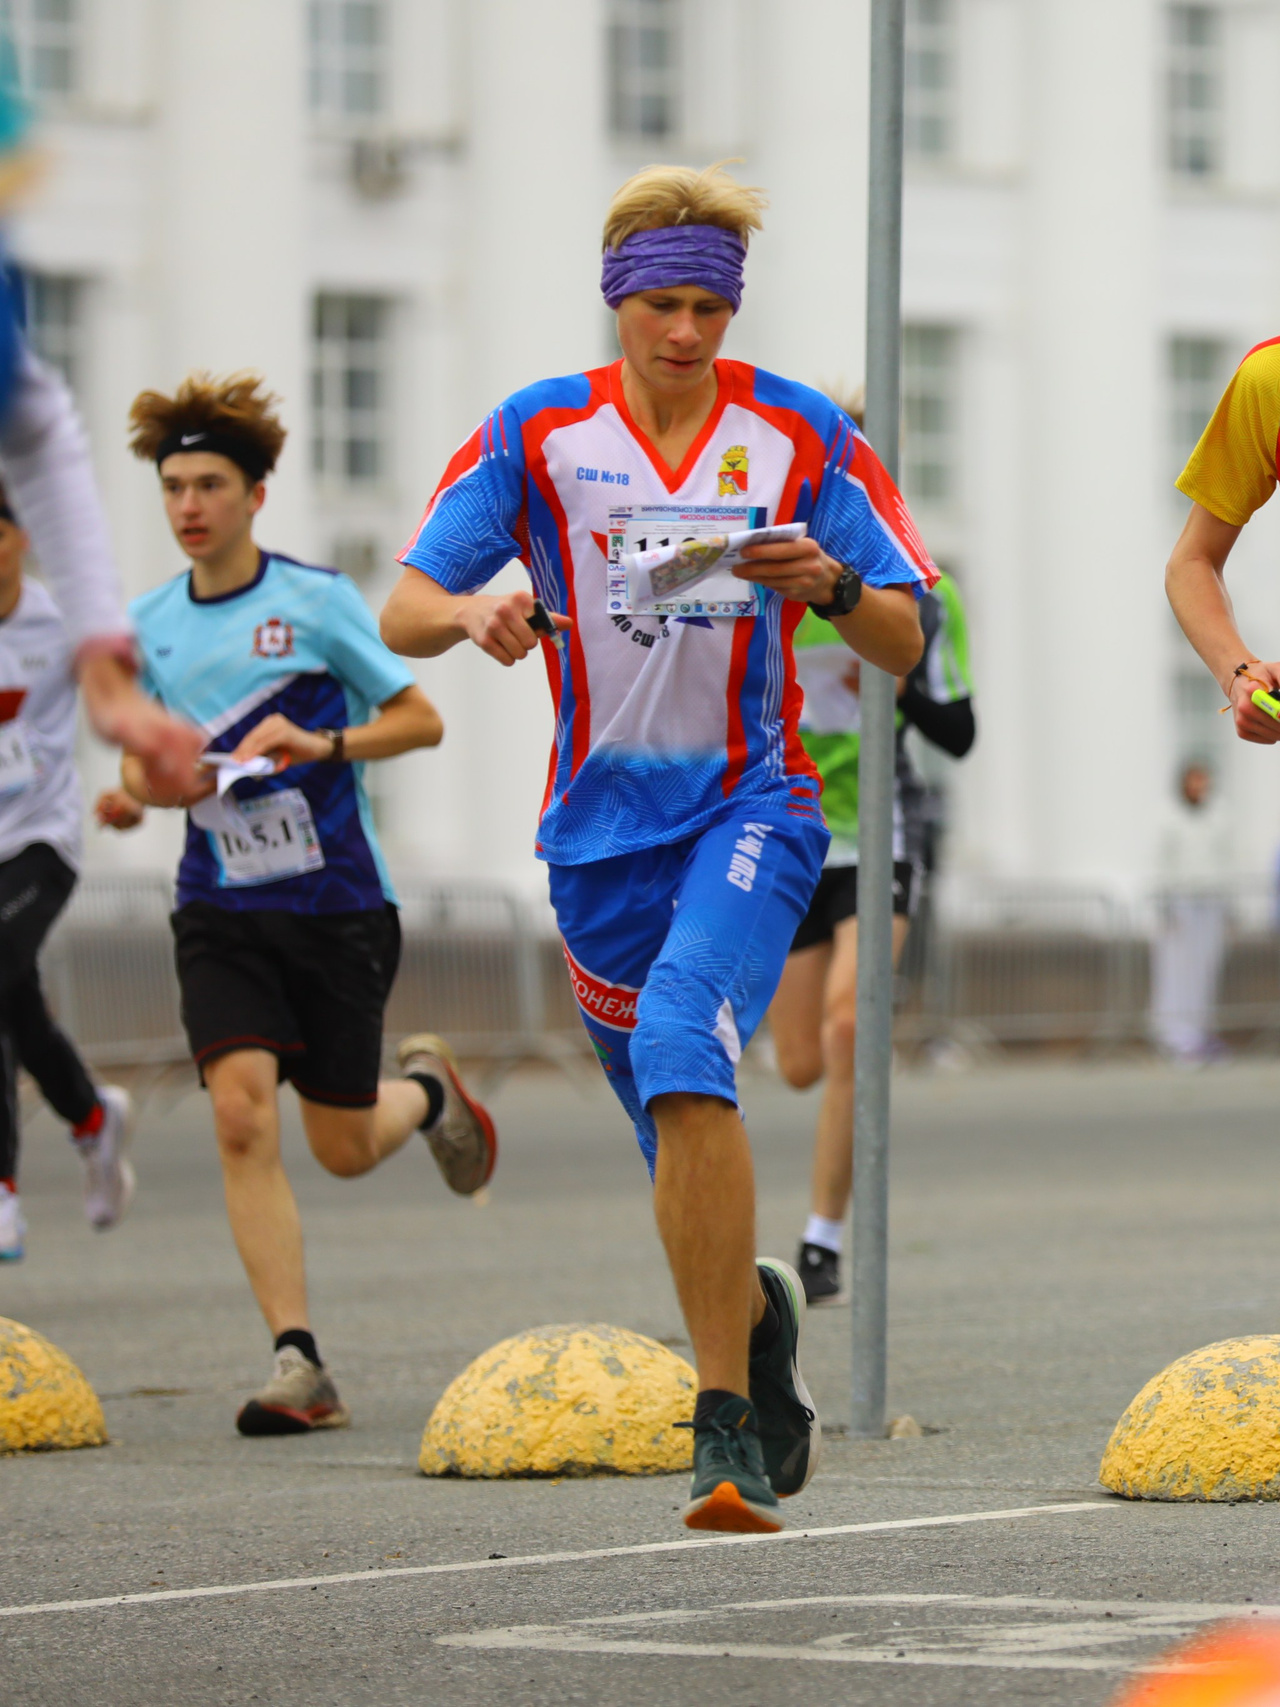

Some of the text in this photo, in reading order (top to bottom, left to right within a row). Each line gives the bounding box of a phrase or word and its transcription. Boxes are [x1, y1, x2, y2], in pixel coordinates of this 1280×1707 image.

[576, 466, 630, 486] СШ №18
[631, 629, 656, 648] СШ
[726, 852, 758, 893] СШ
[563, 950, 638, 1020] РОНЕЖ
